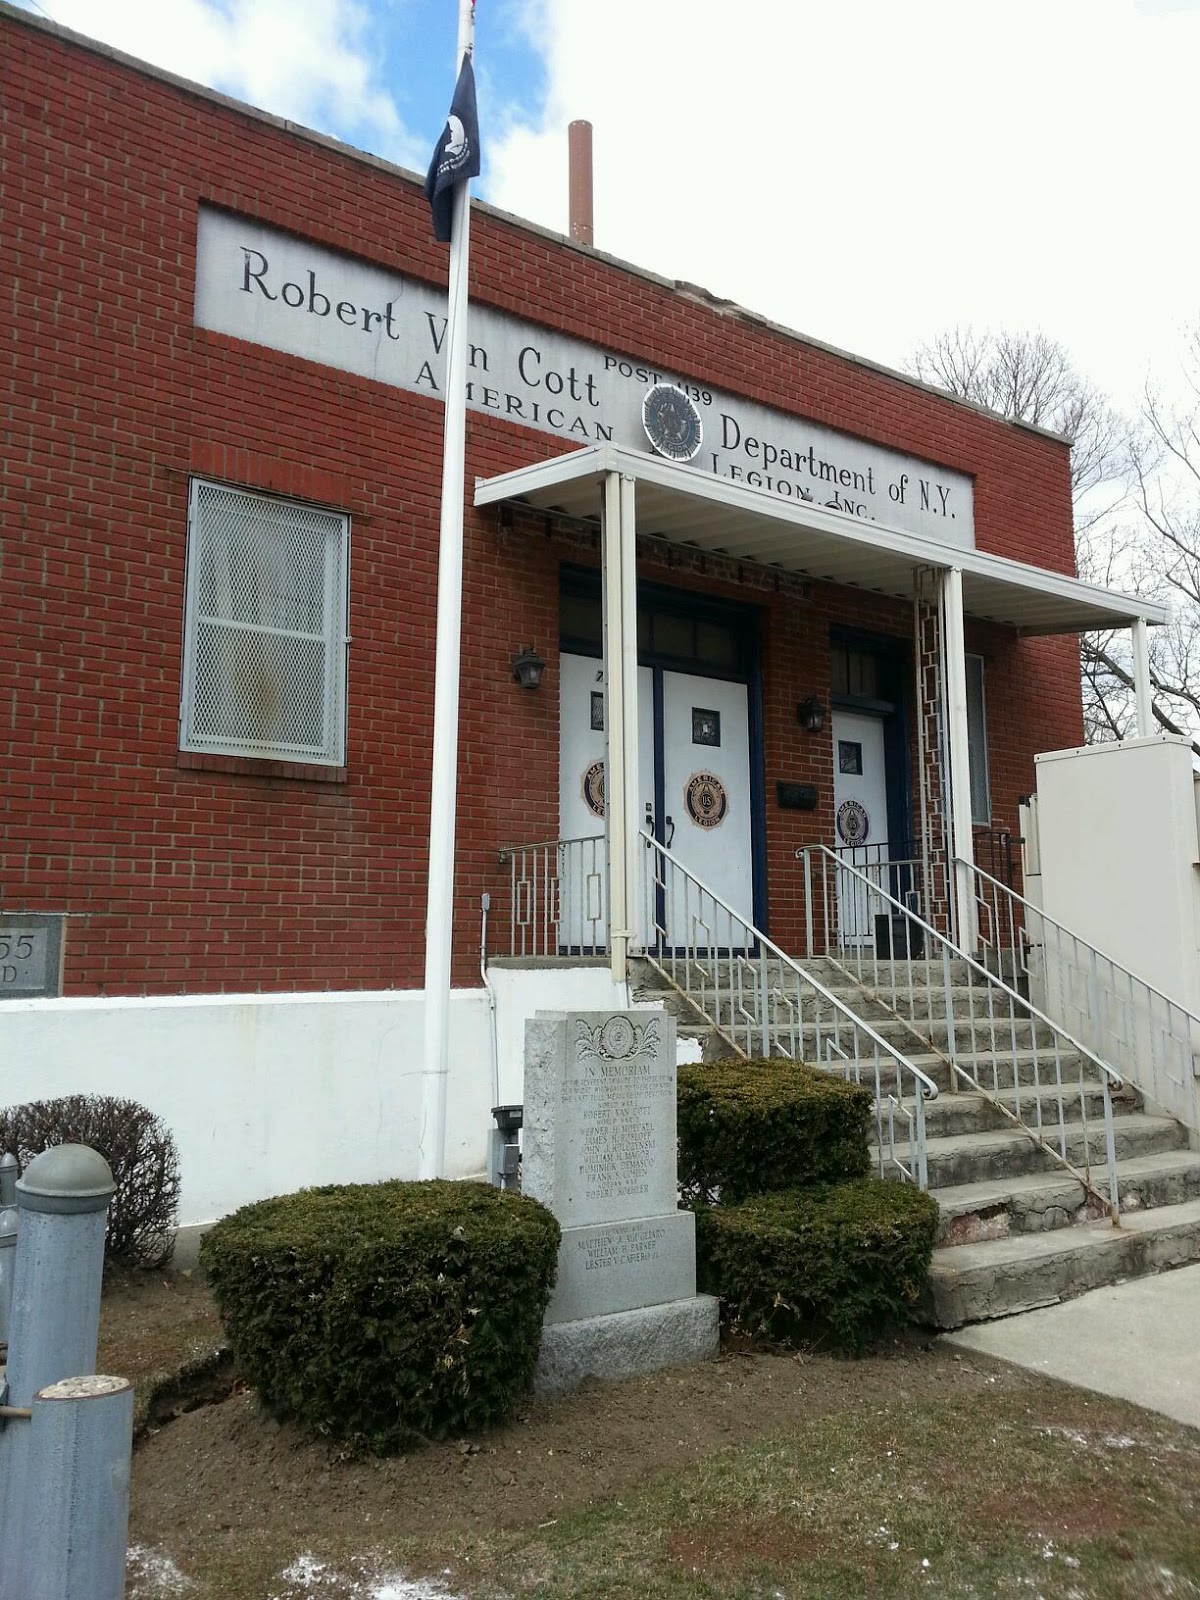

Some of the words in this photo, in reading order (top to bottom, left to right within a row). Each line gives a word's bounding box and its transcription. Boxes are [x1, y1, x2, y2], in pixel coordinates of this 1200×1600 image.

[604, 355, 662, 385] POST
[239, 246, 400, 341] Robert
[423, 311, 490, 372] Vn
[518, 346, 600, 407] Cott
[719, 413, 878, 495] Department
[888, 474, 908, 504] of
[918, 479, 956, 519] N.Y.
[689, 775, 725, 794] AMERICAN
[695, 816, 721, 826] LEGION
[585, 1067, 596, 1078] IN
[601, 1065, 651, 1078] MEMORIAM
